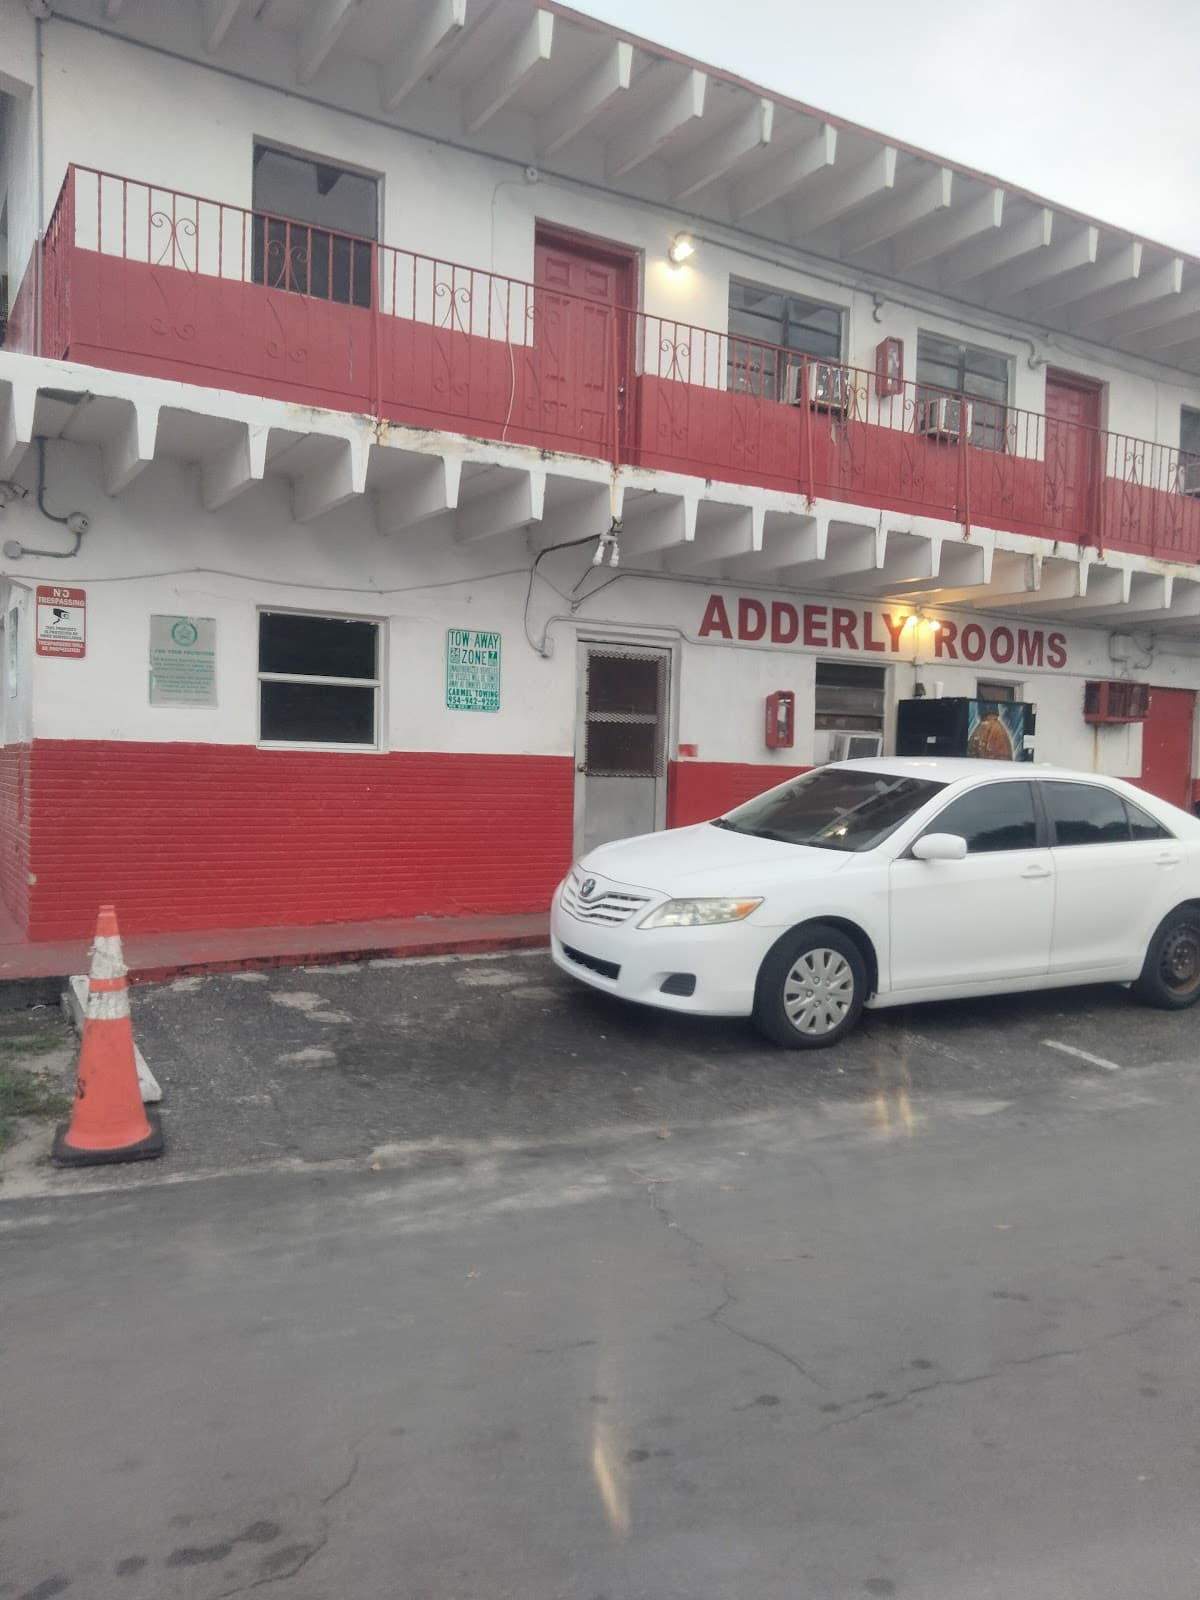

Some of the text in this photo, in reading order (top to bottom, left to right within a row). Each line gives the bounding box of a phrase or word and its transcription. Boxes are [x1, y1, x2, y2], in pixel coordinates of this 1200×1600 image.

[53, 588, 69, 597] NO
[38, 596, 85, 607] TRESPASSING
[697, 593, 1068, 669] ADDERLY ROOMS
[449, 631, 499, 649] TOW AWAY
[461, 649, 487, 666] ZONE
[448, 688, 498, 698] CARMEL TOWING
